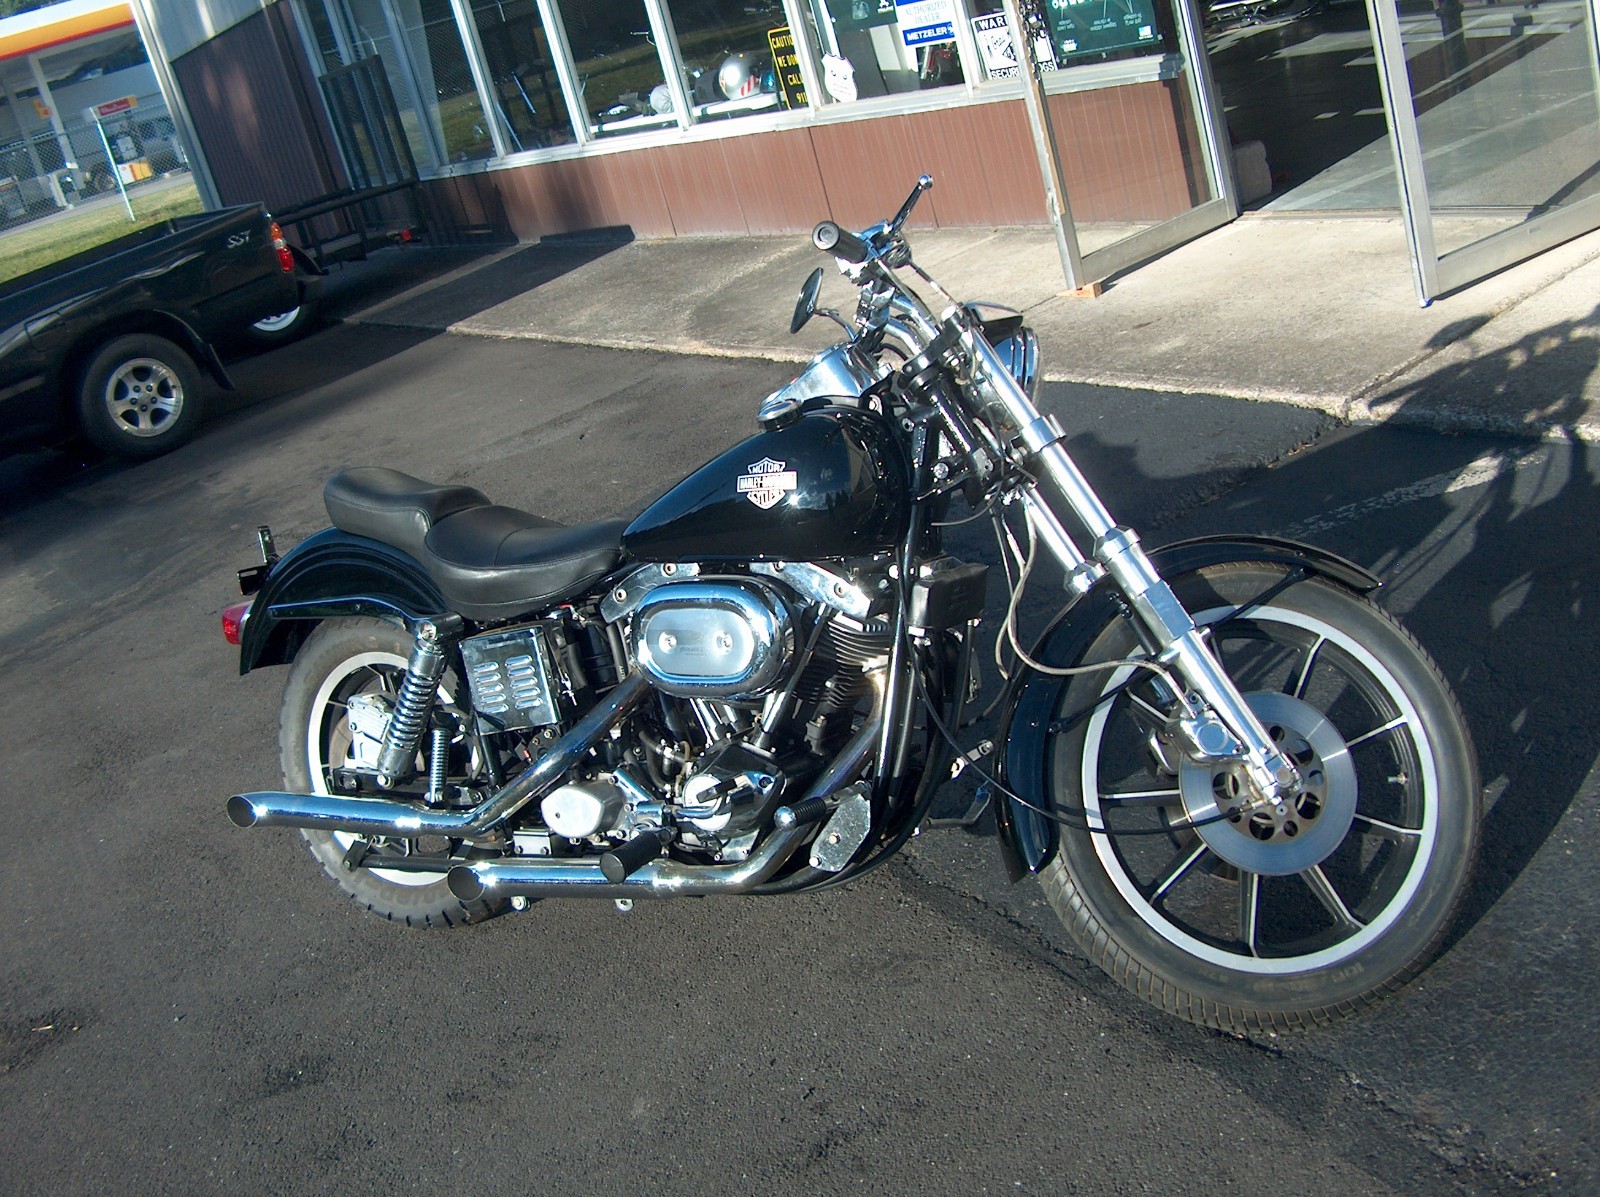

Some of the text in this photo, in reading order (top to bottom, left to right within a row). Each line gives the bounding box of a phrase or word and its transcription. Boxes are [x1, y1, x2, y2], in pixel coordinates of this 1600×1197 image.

[906, 26, 948, 41] METZELER
[771, 34, 794, 49] CAUTIO
[777, 56, 788, 68] WE
[991, 66, 1019, 80] SECURI
[752, 461, 781, 474] MOTOR
